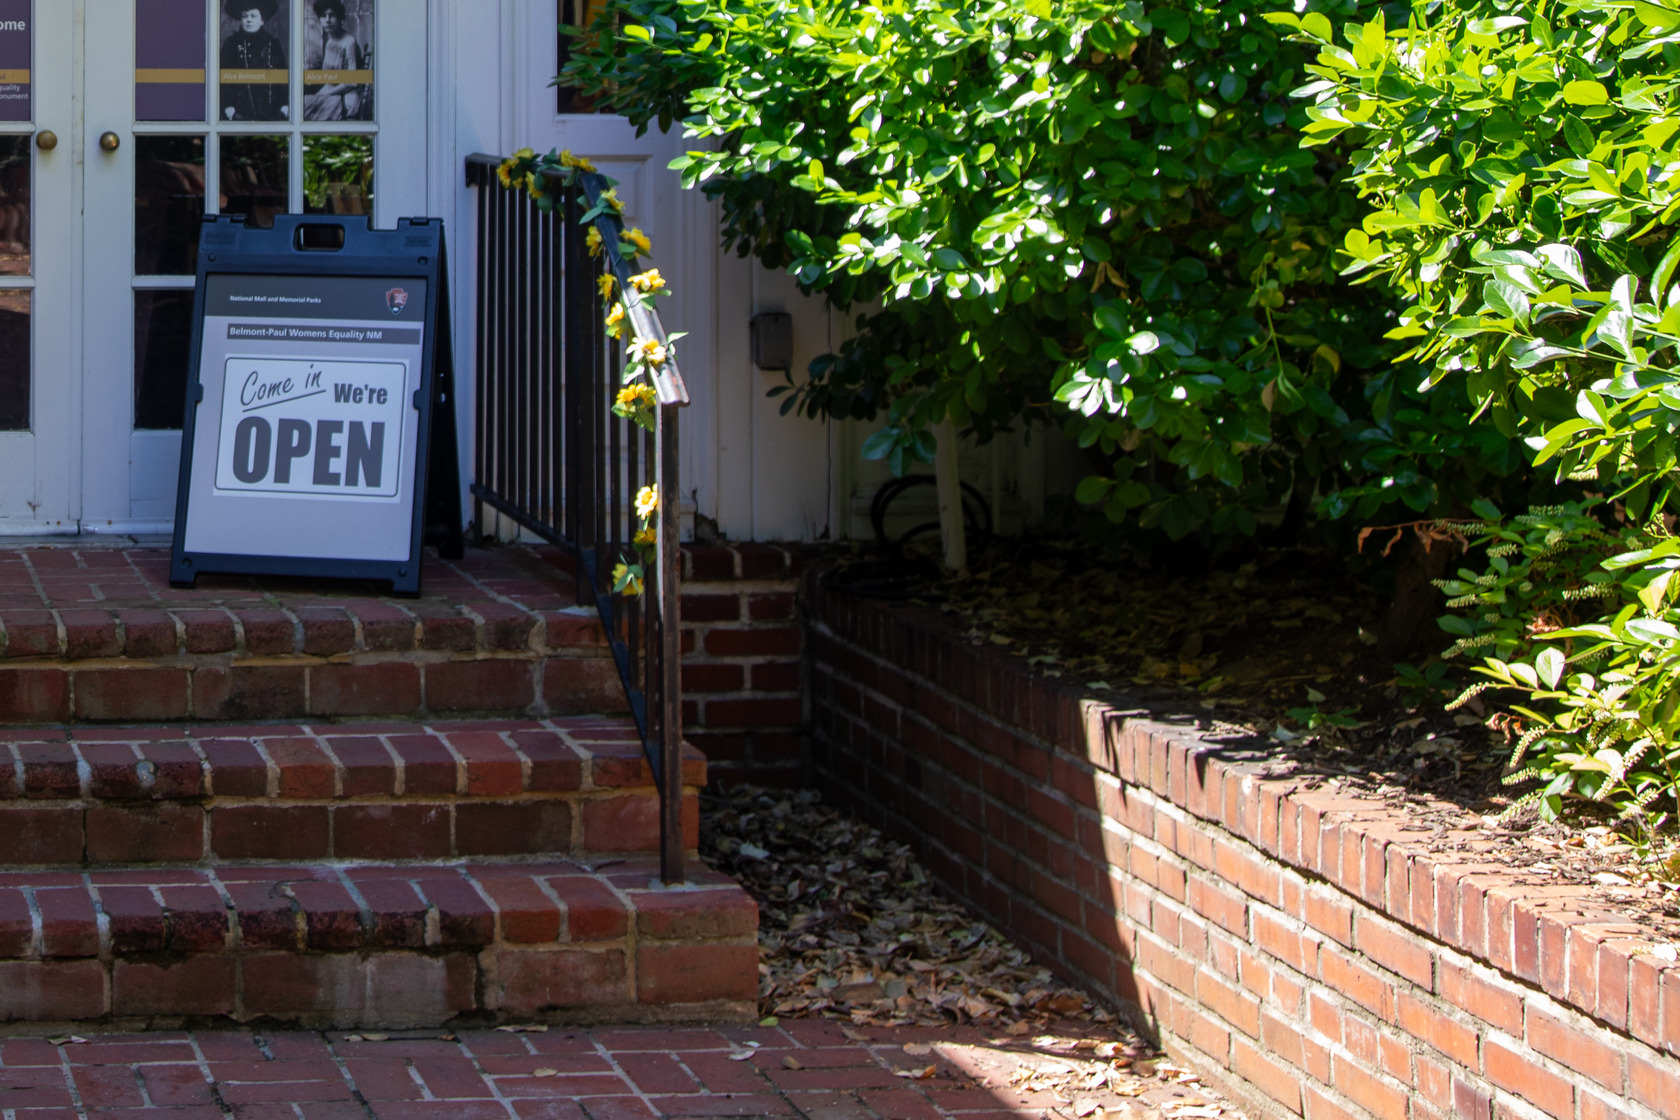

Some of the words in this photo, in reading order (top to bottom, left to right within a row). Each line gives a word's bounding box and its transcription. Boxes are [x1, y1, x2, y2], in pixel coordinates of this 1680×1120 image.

[238, 72, 266, 80] Belmont
[229, 326, 287, 337] Belmont-Paul
[289, 329, 327, 338] Womens
[328, 330, 365, 341] Equality
[366, 331, 383, 340] NM
[240, 371, 295, 406] Come
[305, 363, 322, 389] in
[333, 383, 389, 405] We're
[232, 416, 386, 488] OPEN
